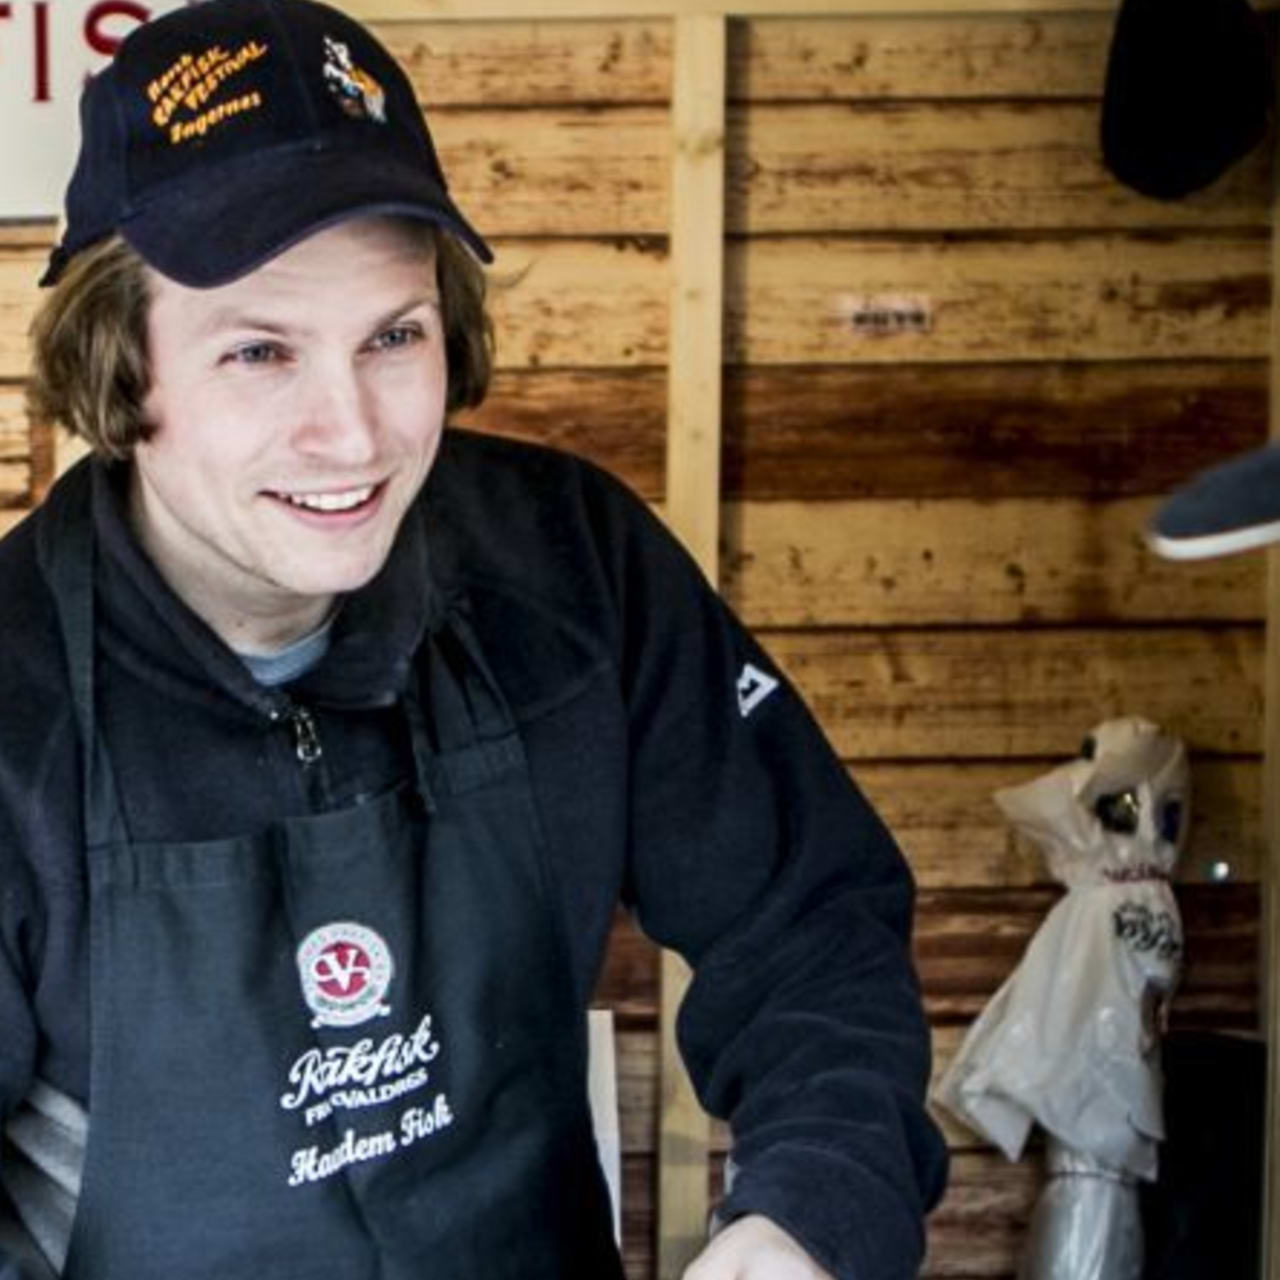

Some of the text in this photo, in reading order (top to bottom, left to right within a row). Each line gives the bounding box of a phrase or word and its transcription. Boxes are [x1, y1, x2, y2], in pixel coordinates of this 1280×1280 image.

[184, 40, 268, 111] FESTIVAL
[287, 1092, 454, 1187] Haadem Fisk
